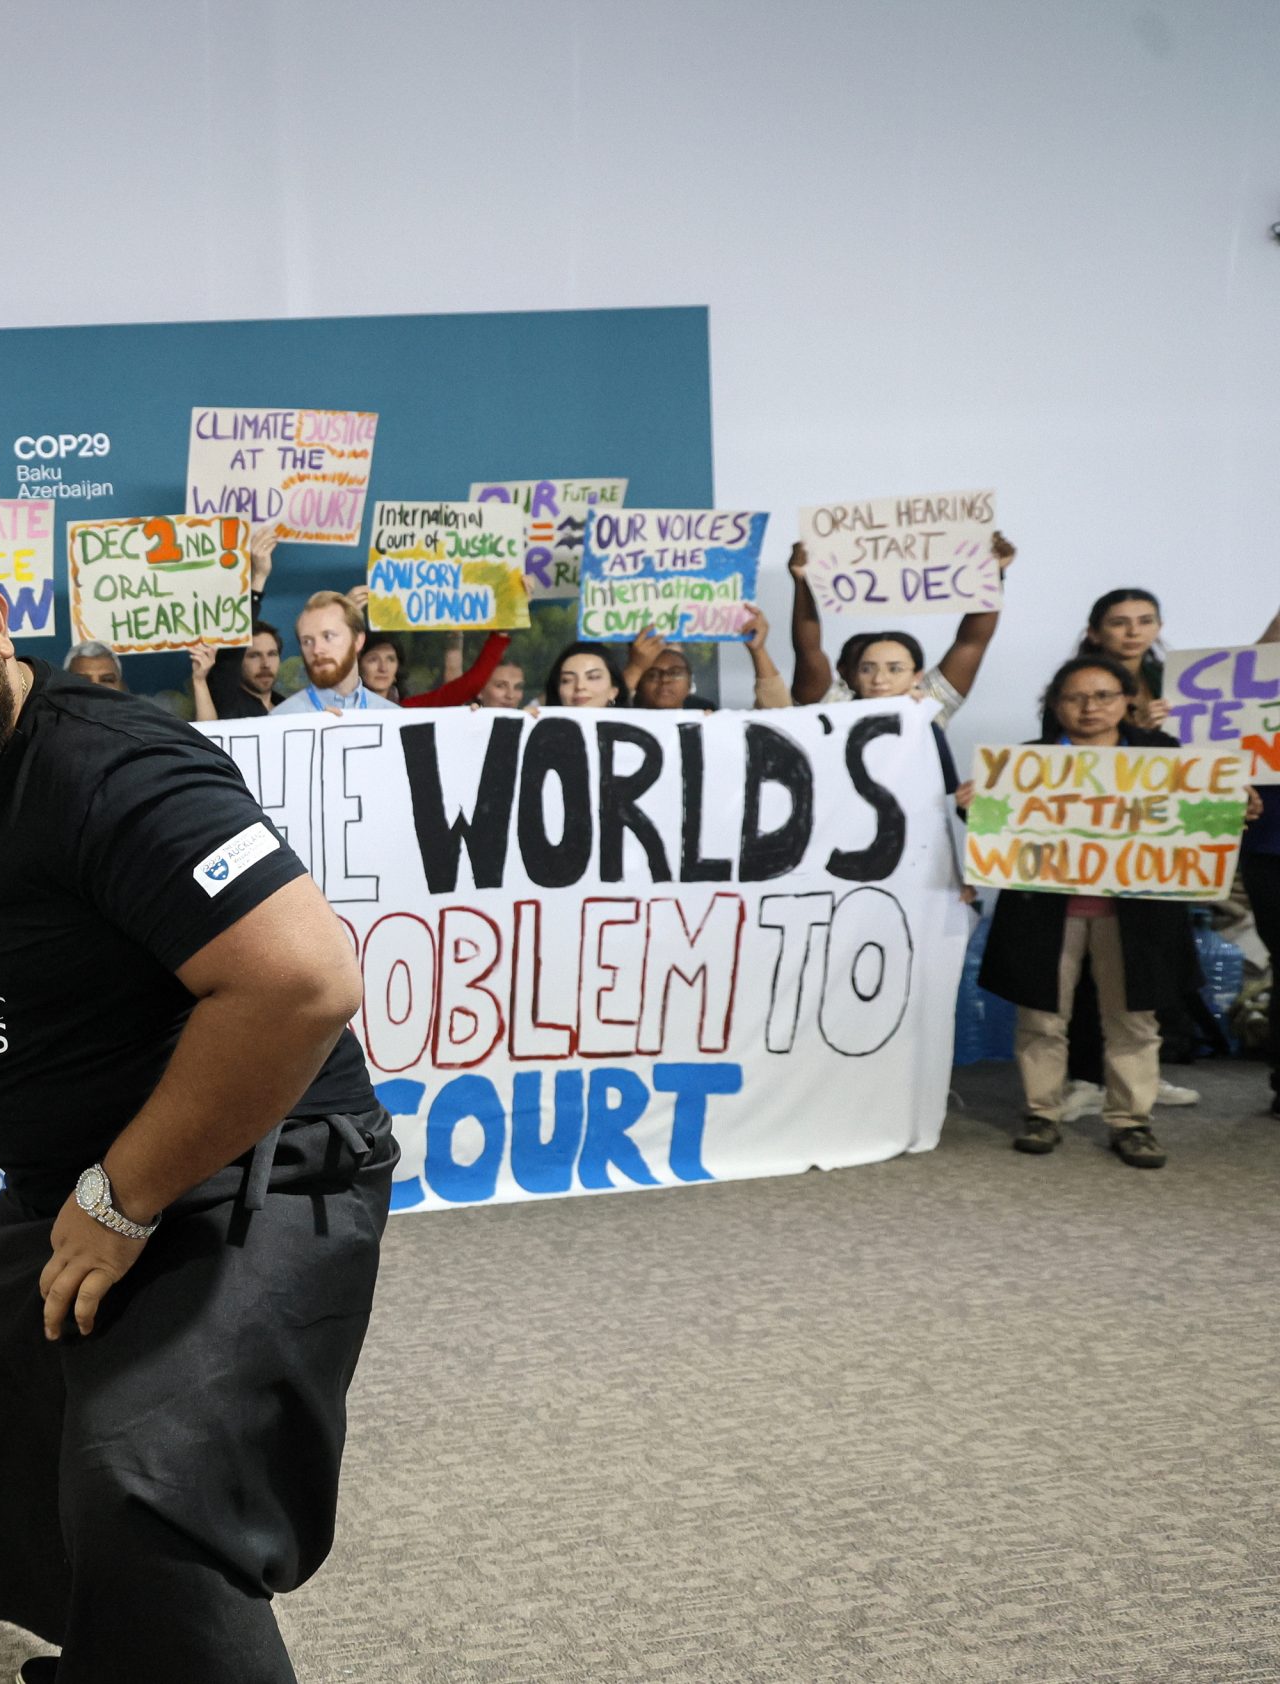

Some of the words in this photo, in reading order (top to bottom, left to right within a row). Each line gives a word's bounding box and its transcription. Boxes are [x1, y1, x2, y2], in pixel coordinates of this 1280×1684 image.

[14, 432, 111, 460] COP29
[196, 411, 295, 441] CLIMATE
[303, 412, 377, 445] JUSTICE
[16, 464, 62, 481] Baku
[230, 448, 264, 470] AT
[278, 447, 325, 470] THE
[18, 480, 113, 500] Azerbaijan
[288, 487, 367, 530] COURT
[812, 502, 889, 538] ORAL
[895, 492, 994, 525] HEARINGS
[78, 527, 140, 565] DEC
[375, 529, 417, 556] Court
[425, 530, 441, 553] of
[596, 513, 647, 549] OUR
[657, 511, 750, 545] VOICES
[609, 550, 646, 573] AT
[655, 547, 703, 569] THE
[850, 532, 946, 565] START
[93, 572, 174, 603] ORAL
[832, 569, 889, 603] 02
[901, 564, 975, 602] DEC
[656, 603, 680, 632] of
[980, 748, 1106, 793] YOUR
[1114, 752, 1241, 795] VOICE
[399, 713, 907, 894] WORLD'S
[1017, 793, 1083, 827] AT
[1084, 794, 1170, 833] THE
[968, 838, 1107, 886] WORLD
[1115, 839, 1238, 888] COURT
[759, 886, 914, 1057] TO
